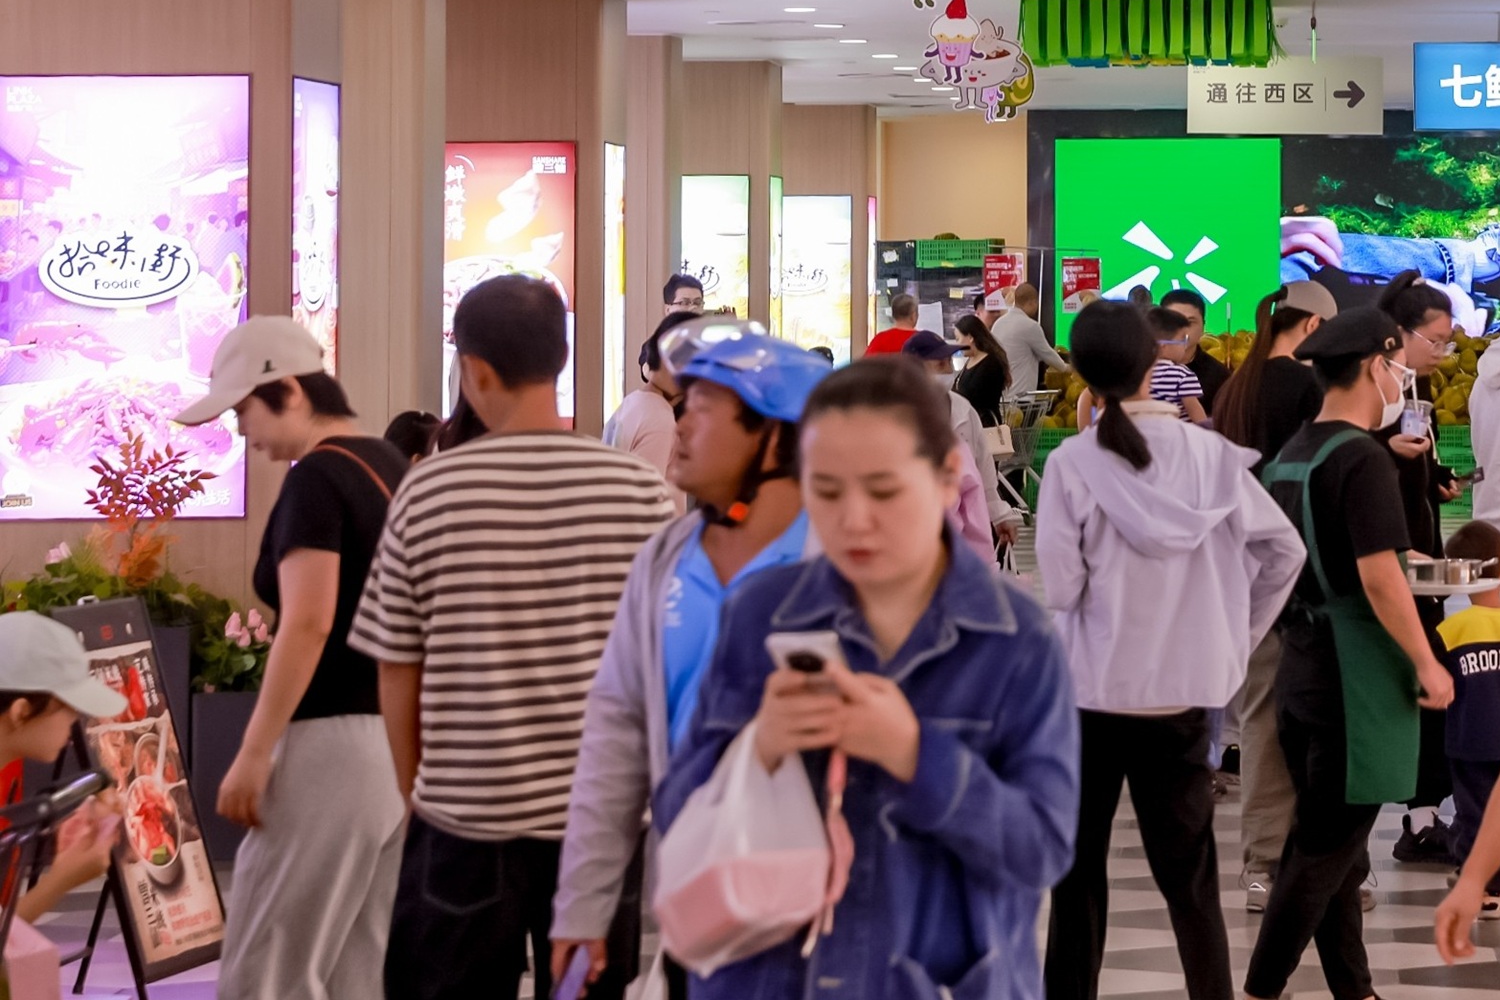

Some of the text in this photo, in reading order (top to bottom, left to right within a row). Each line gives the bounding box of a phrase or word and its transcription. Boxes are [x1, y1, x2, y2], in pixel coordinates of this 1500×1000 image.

[1206, 82, 1314, 104] 通往西区
[94, 278, 142, 290] Foodie
